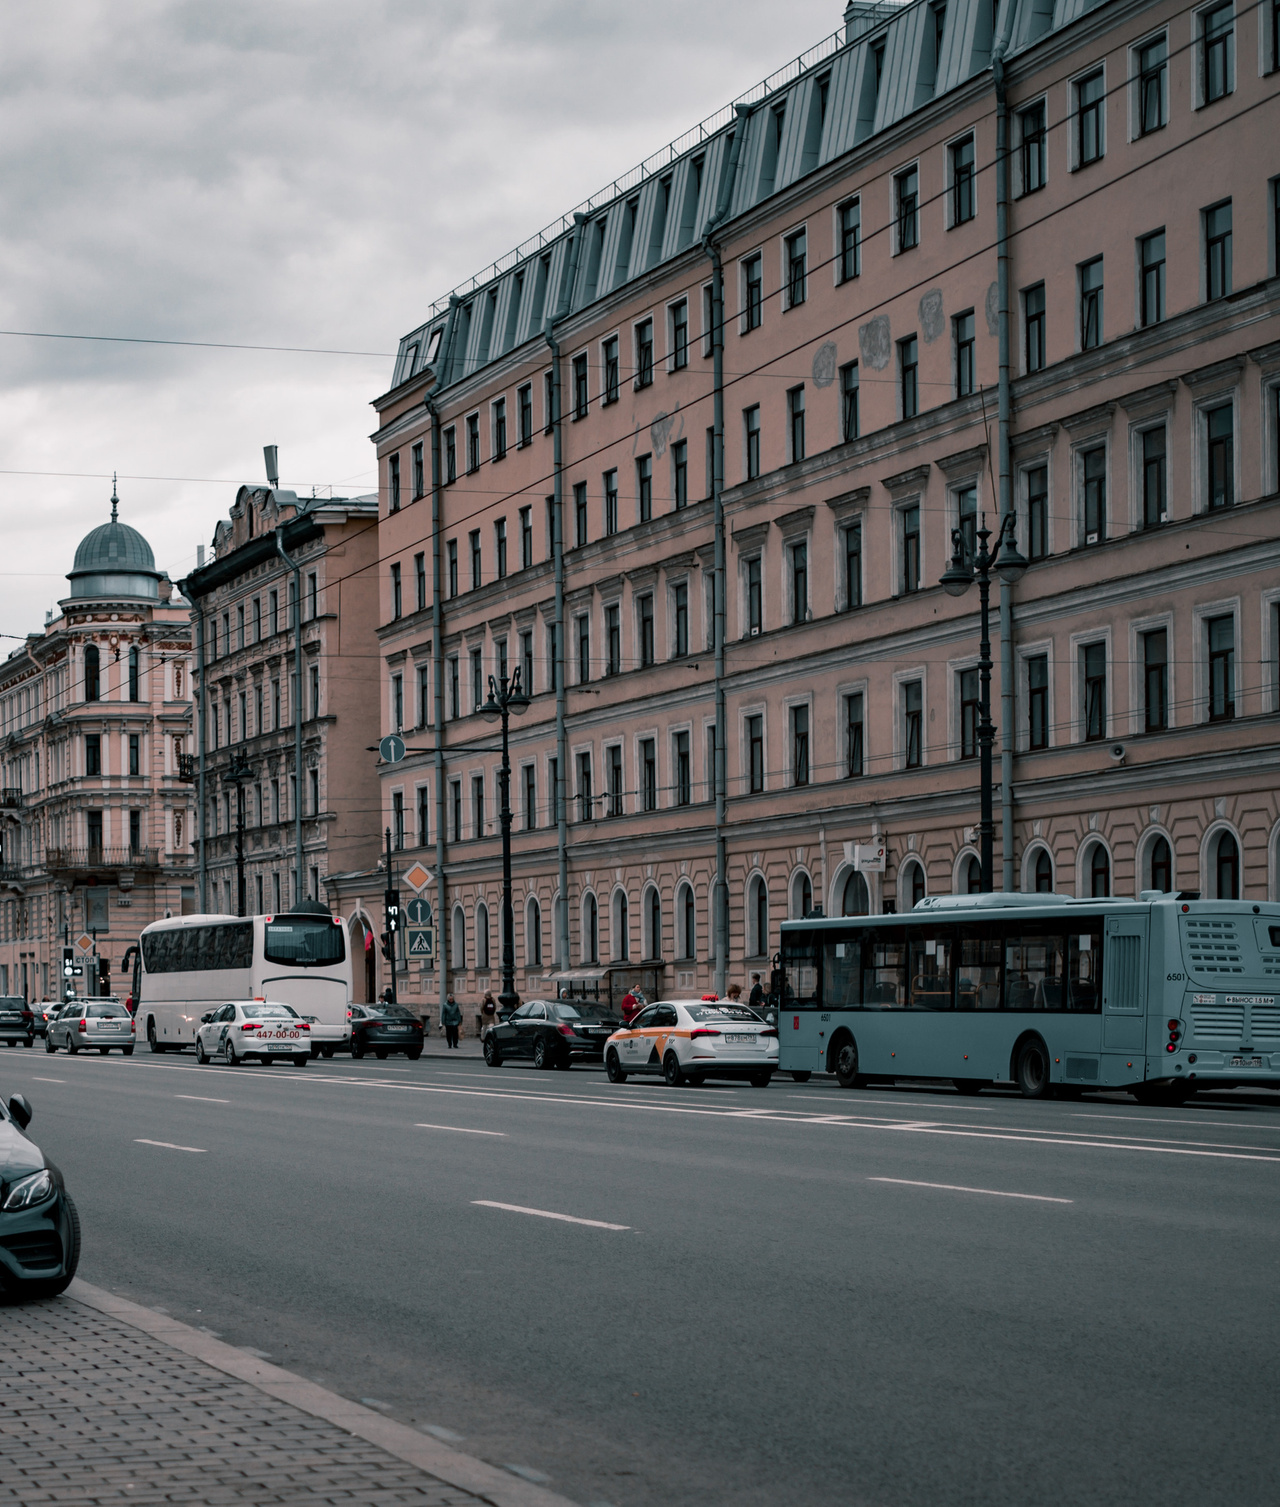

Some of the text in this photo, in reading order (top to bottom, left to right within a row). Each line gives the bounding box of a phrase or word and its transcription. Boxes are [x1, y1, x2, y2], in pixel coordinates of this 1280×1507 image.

[388, 905, 398, 915] 47
[1166, 973, 1185, 981] 6501
[821, 1013, 831, 1022] 6501
[256, 1030, 300, 1039] 447-00-00
